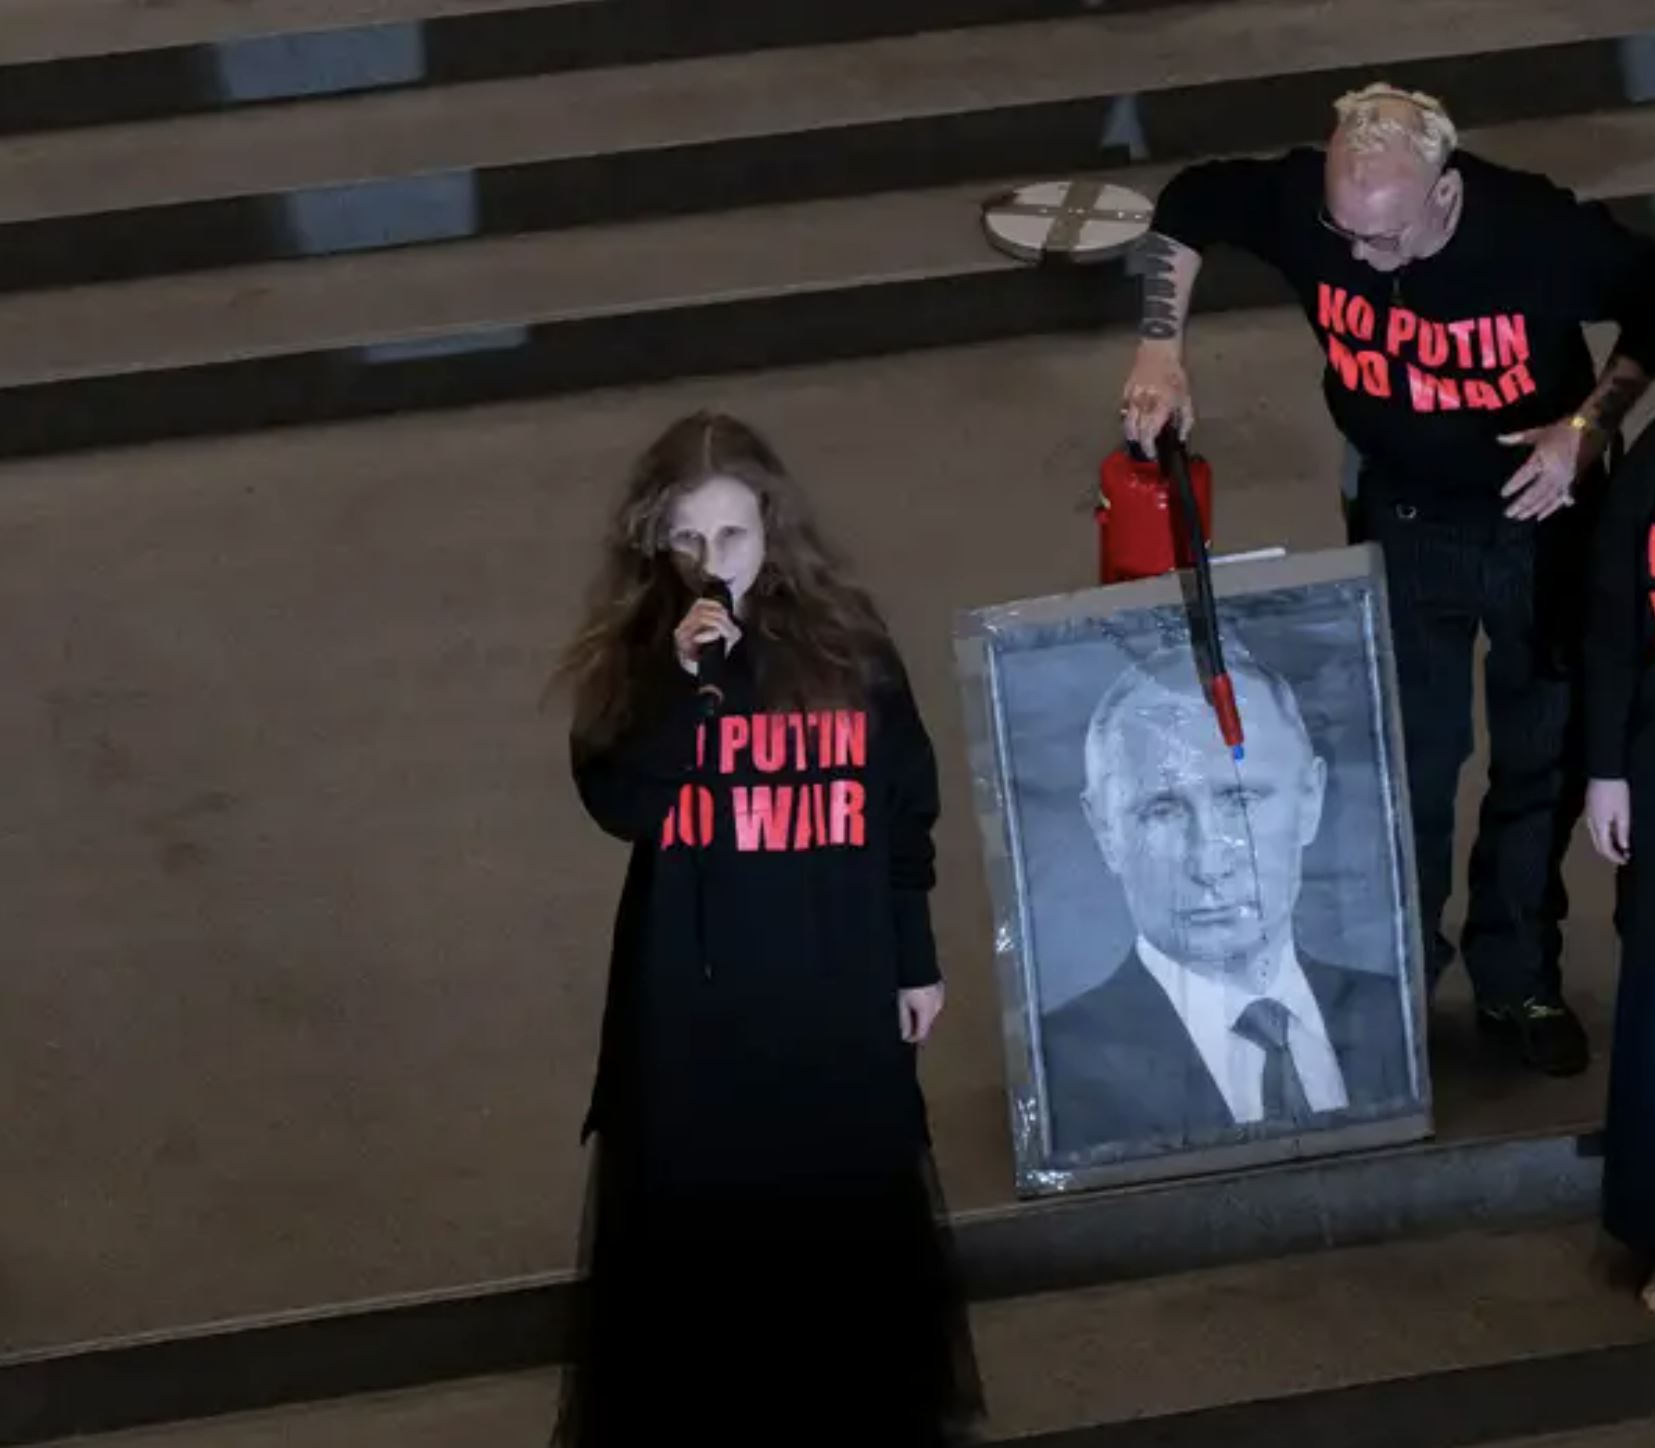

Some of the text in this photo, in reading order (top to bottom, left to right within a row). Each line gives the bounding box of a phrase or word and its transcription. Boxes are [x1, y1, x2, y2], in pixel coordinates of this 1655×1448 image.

[1317, 282, 1530, 370] NO PUTIN
[1328, 333, 1392, 398] NO
[718, 709, 868, 775] PUTIN
[661, 778, 867, 852] O WAR
